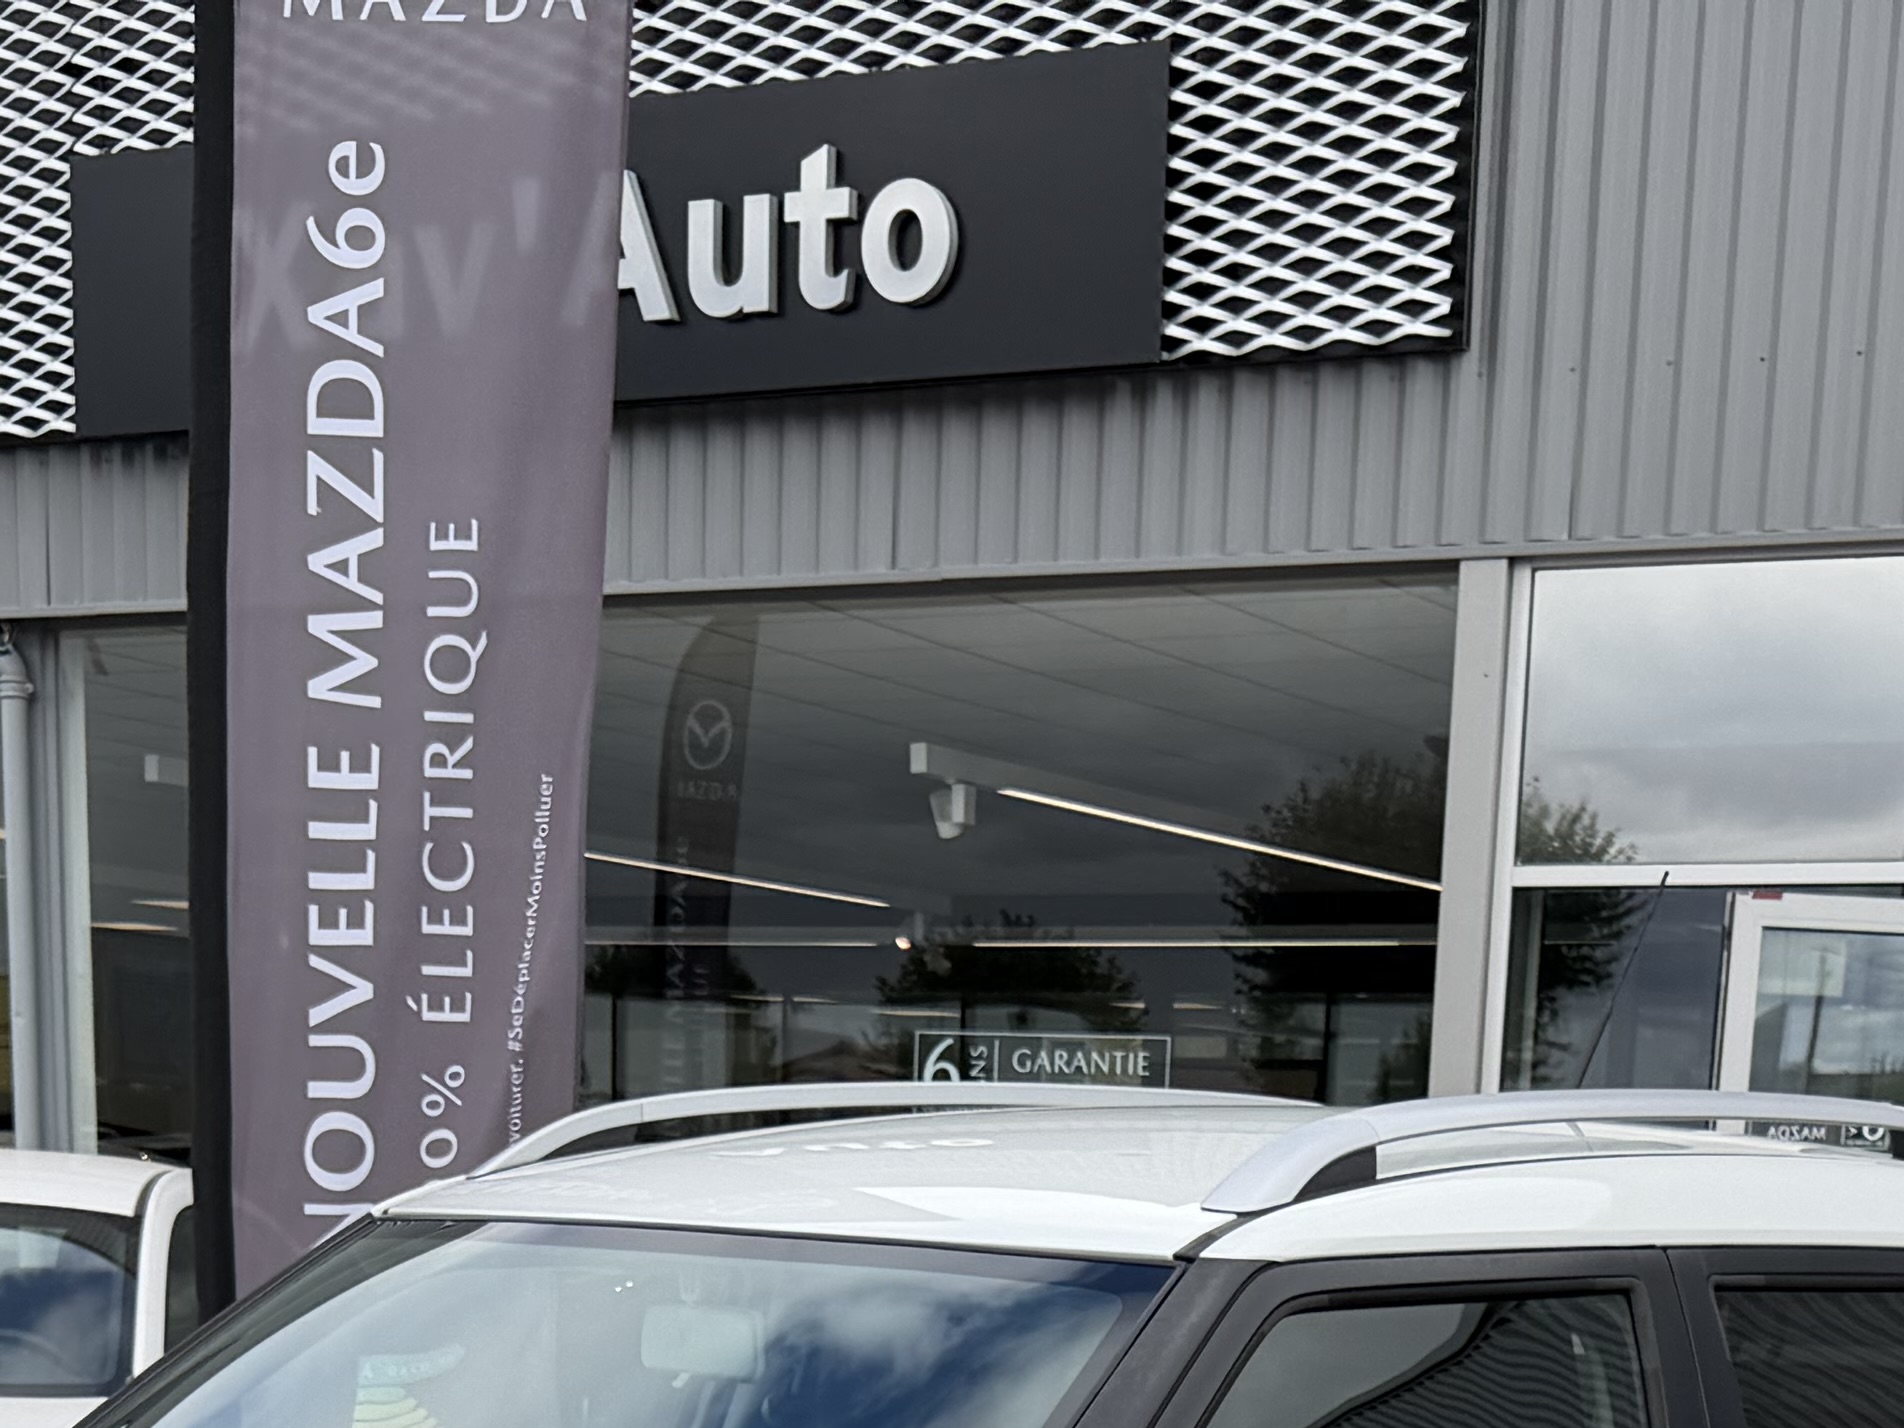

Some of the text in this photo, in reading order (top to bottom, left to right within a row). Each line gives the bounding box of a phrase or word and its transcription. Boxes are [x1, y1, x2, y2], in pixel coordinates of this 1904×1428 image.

[306, 140, 385, 708] MAZDA6e
[406, 518, 488, 1022] ÉLECTRIQUE
[969, 1045, 988, 1082] NS
[1012, 1049, 1150, 1076] GARANTIE
